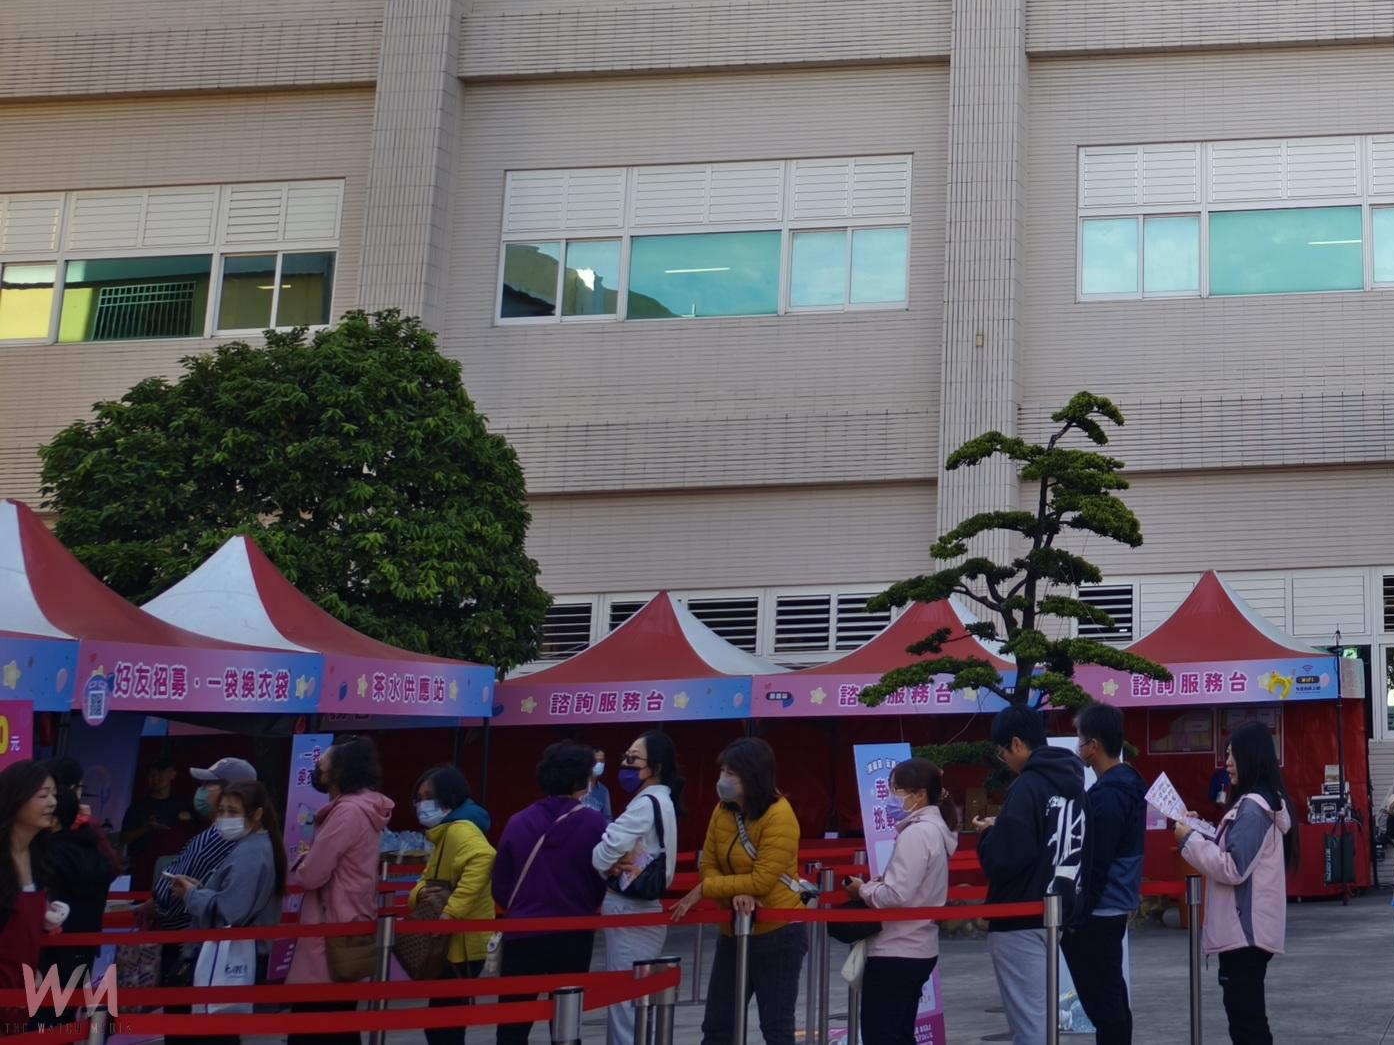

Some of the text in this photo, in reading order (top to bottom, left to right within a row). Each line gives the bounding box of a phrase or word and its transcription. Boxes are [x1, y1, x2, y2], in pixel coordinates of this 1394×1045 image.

[548, 689, 664, 715] 諮詢服務台
[839, 684, 953, 707] 諮服務台
